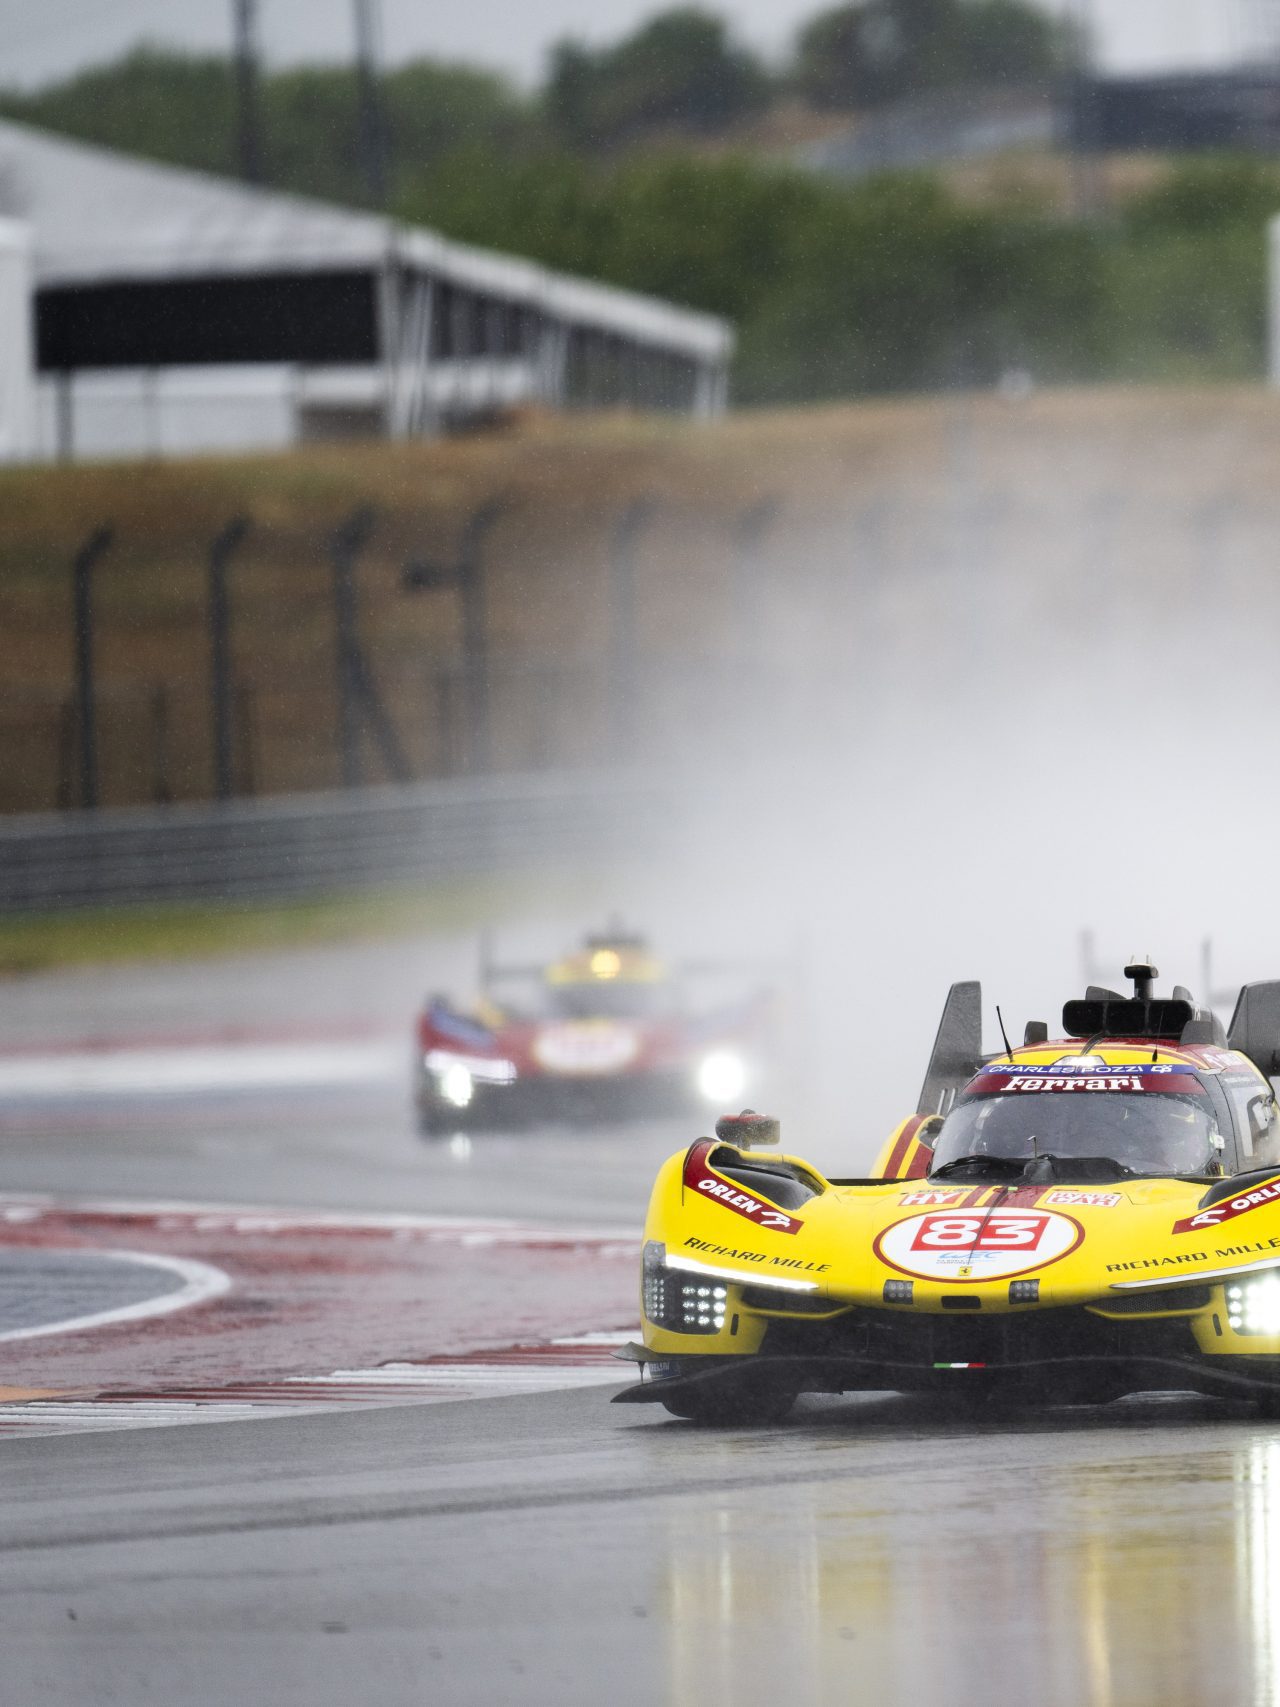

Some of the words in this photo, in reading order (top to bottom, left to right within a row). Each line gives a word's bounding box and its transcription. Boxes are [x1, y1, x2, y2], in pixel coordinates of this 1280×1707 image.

[988, 1065, 1075, 1073] CHARLES
[1000, 1075, 1145, 1091] Ferrari
[697, 1179, 763, 1214] ORLEN
[1051, 1196, 1113, 1206] CAR
[921, 1219, 1041, 1246] 83
[683, 1237, 767, 1262] RICHARD
[769, 1257, 832, 1273] MILLE
[1105, 1251, 1208, 1273] RICHARD
